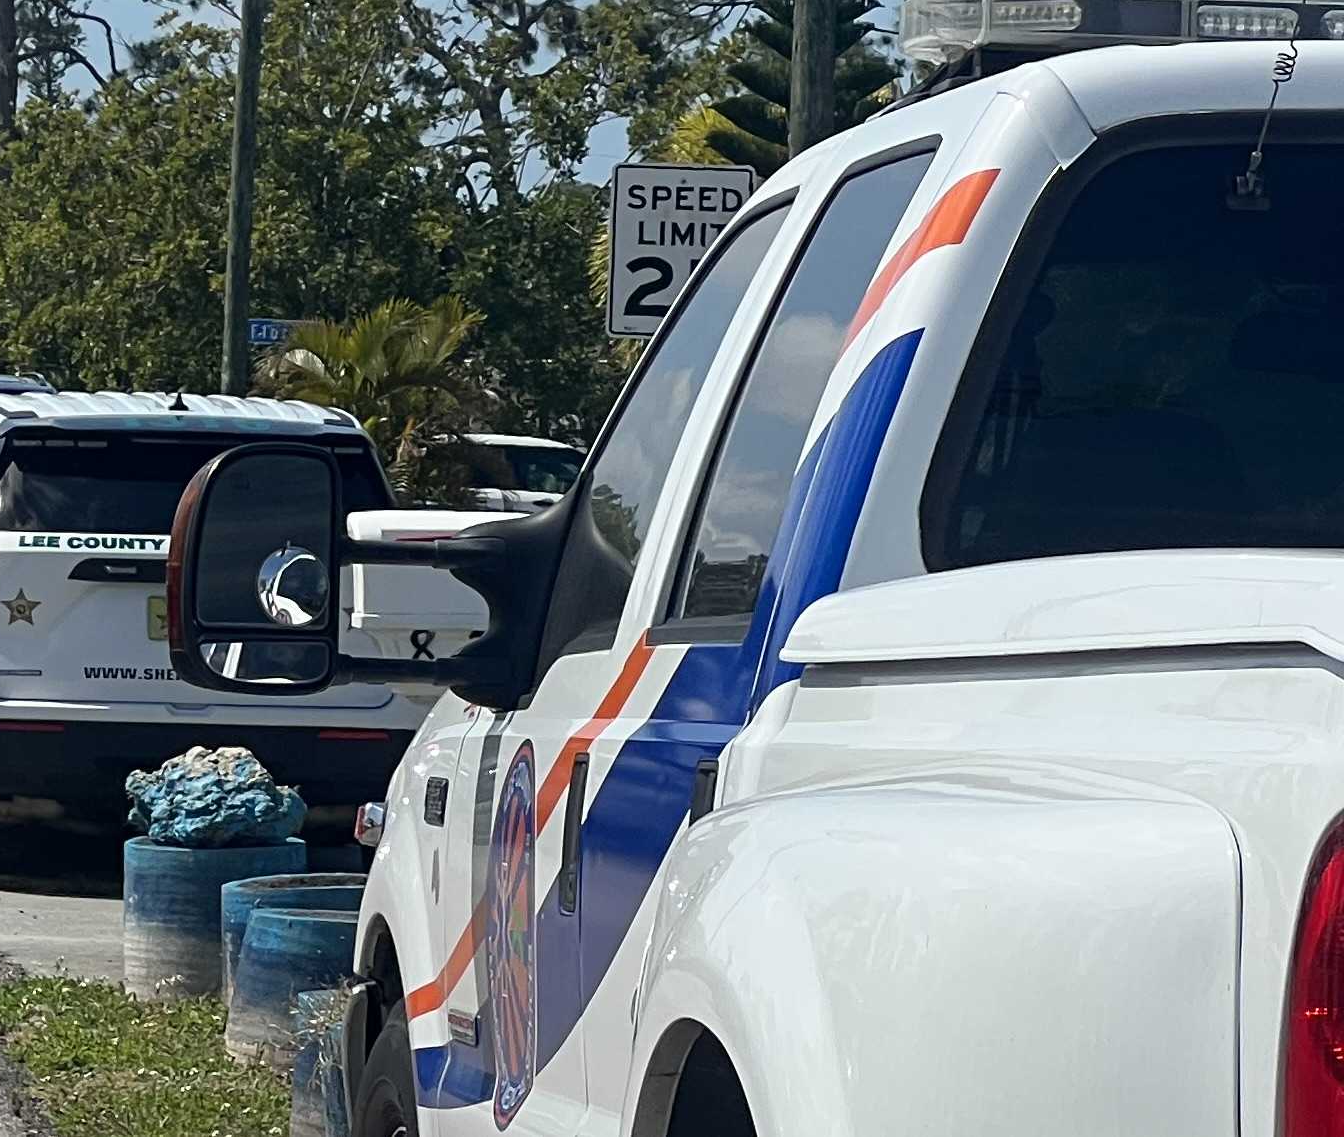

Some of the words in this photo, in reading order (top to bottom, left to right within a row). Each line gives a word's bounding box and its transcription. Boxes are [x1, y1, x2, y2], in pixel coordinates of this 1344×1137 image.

[627, 184, 743, 212] SPEED
[638, 220, 727, 247] LIMIT
[624, 256, 702, 317] 2
[19, 536, 60, 548] LEE
[67, 536, 166, 551] COUNTY
[84, 666, 180, 681] WWW.SHE
